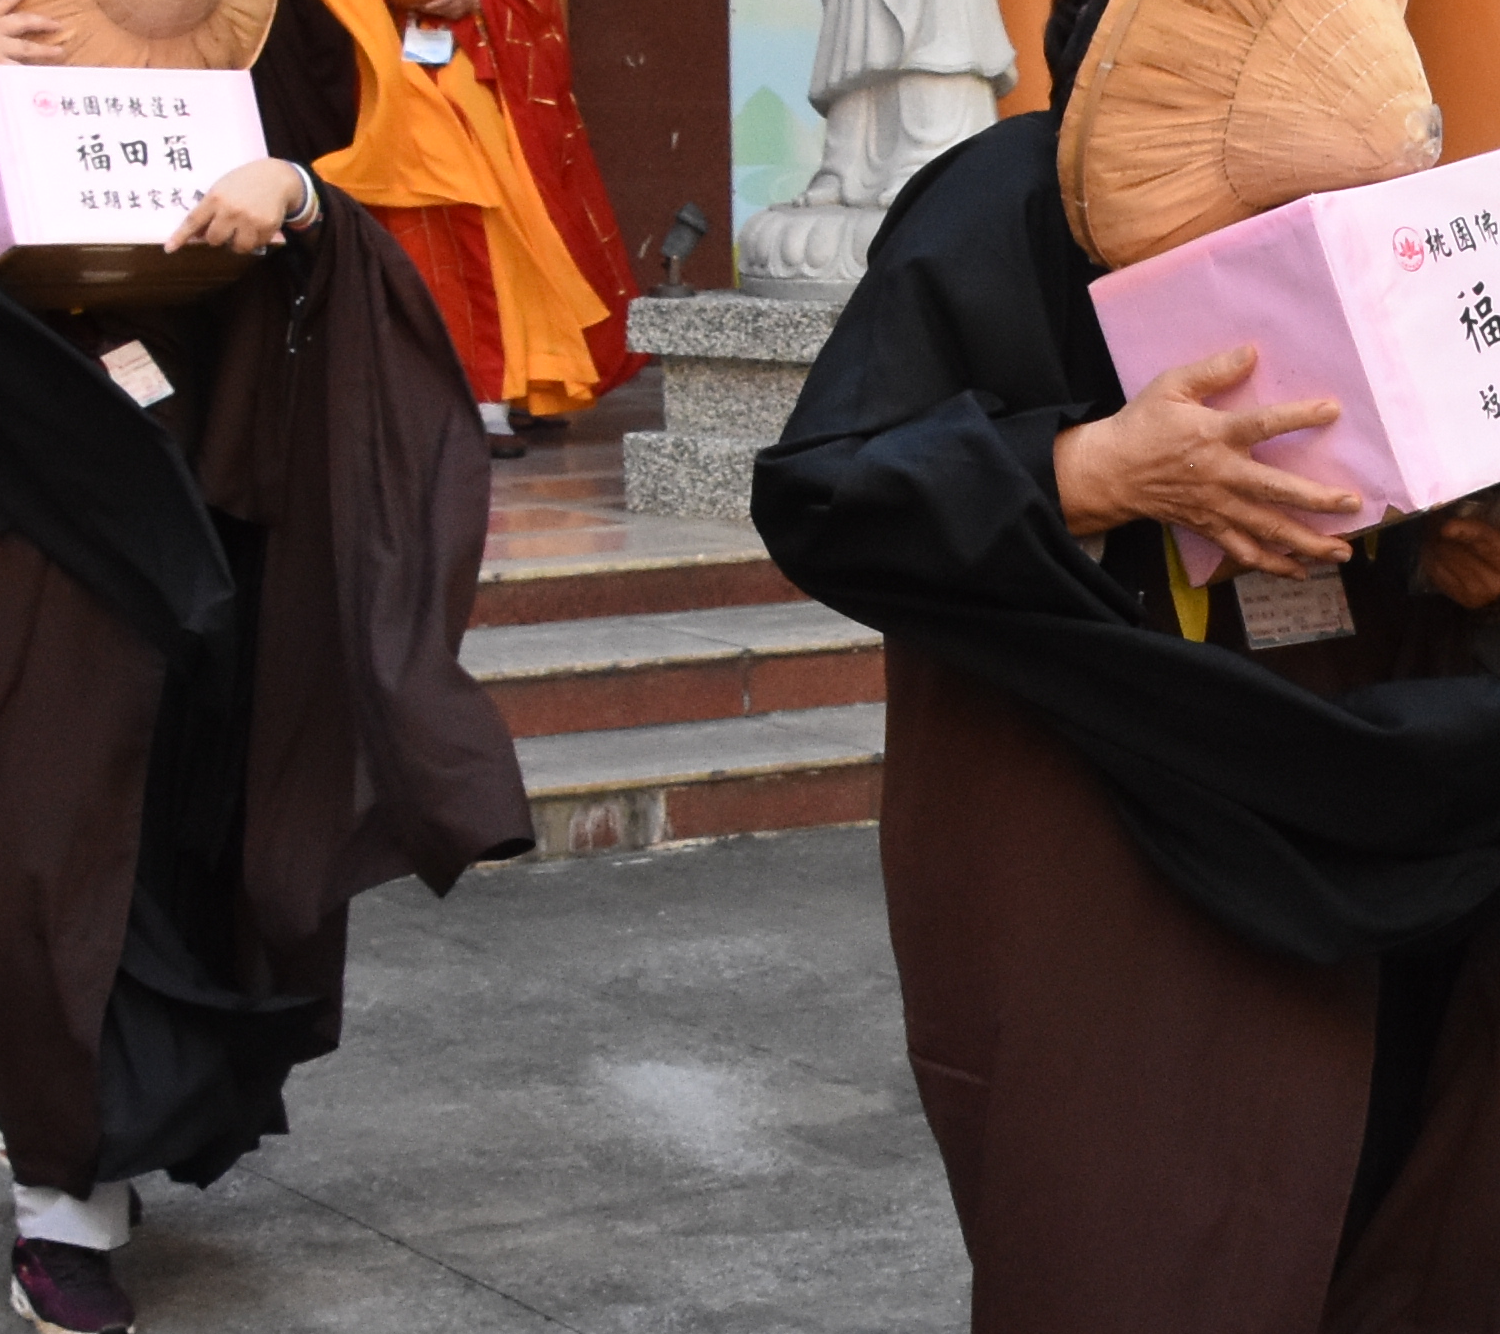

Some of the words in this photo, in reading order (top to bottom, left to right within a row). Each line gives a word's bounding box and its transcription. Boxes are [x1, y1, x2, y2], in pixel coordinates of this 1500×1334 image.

[60, 94, 191, 119] 桃園佛教蓮社
[77, 134, 193, 172] 福田箱
